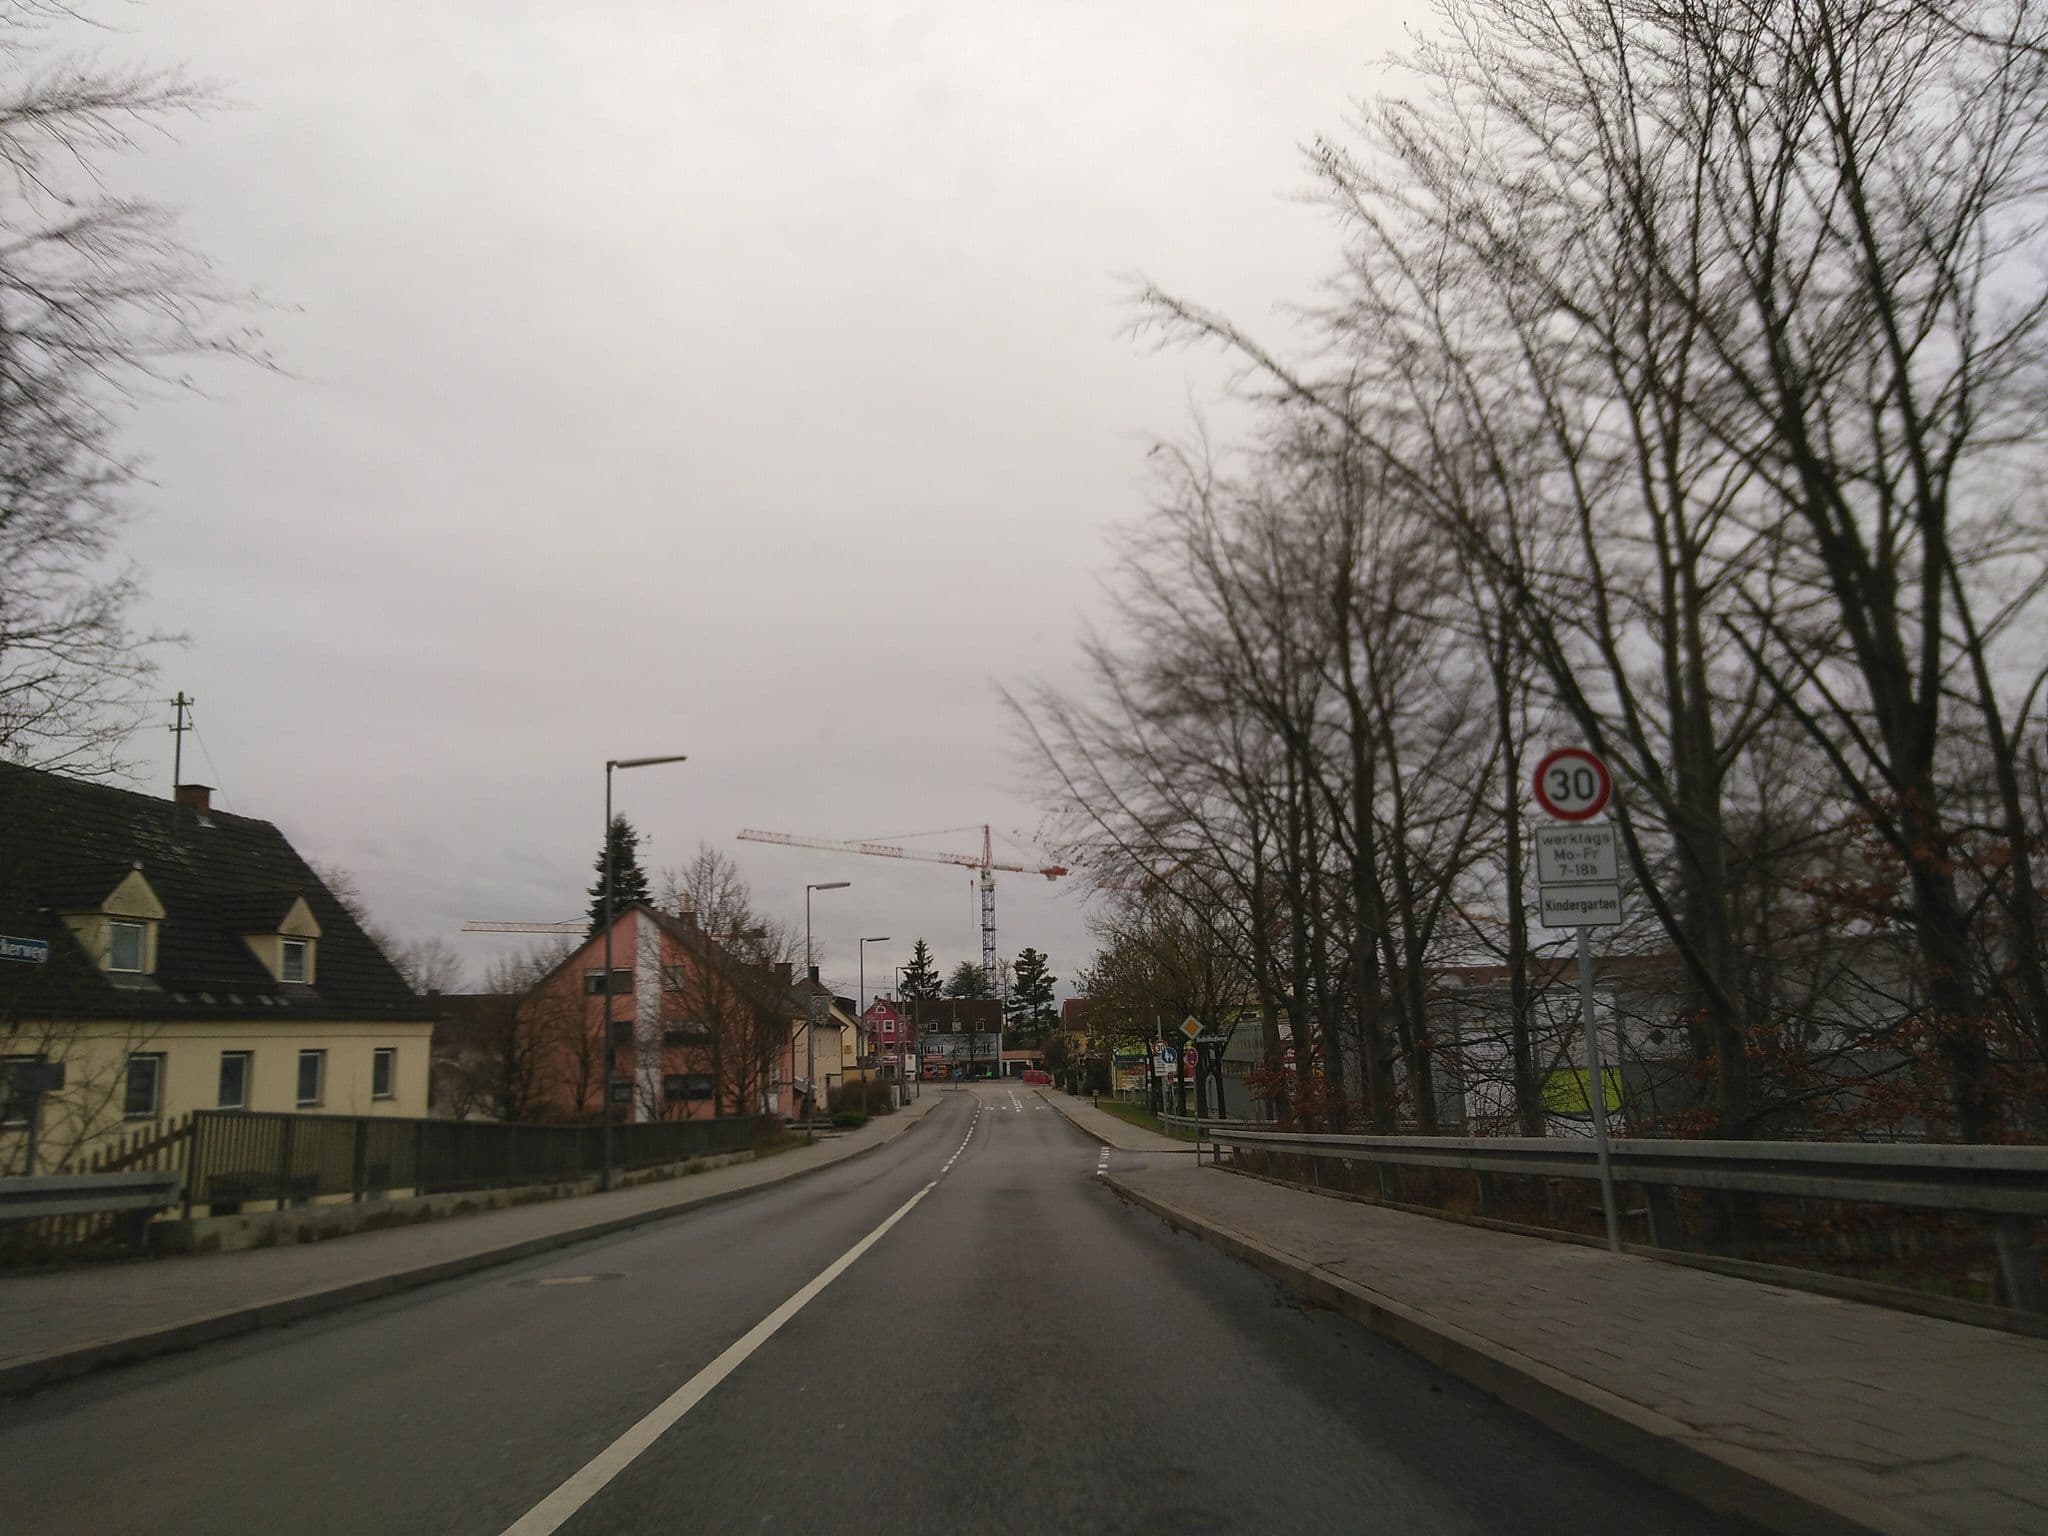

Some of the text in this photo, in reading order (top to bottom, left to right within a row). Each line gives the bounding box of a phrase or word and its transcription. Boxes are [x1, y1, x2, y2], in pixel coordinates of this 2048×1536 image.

[1548, 768, 1595, 801] 30
[1542, 833, 1610, 846] werktags
[1554, 847, 1599, 861] Mo-Fr
[1545, 898, 1617, 913] Kindergarten
